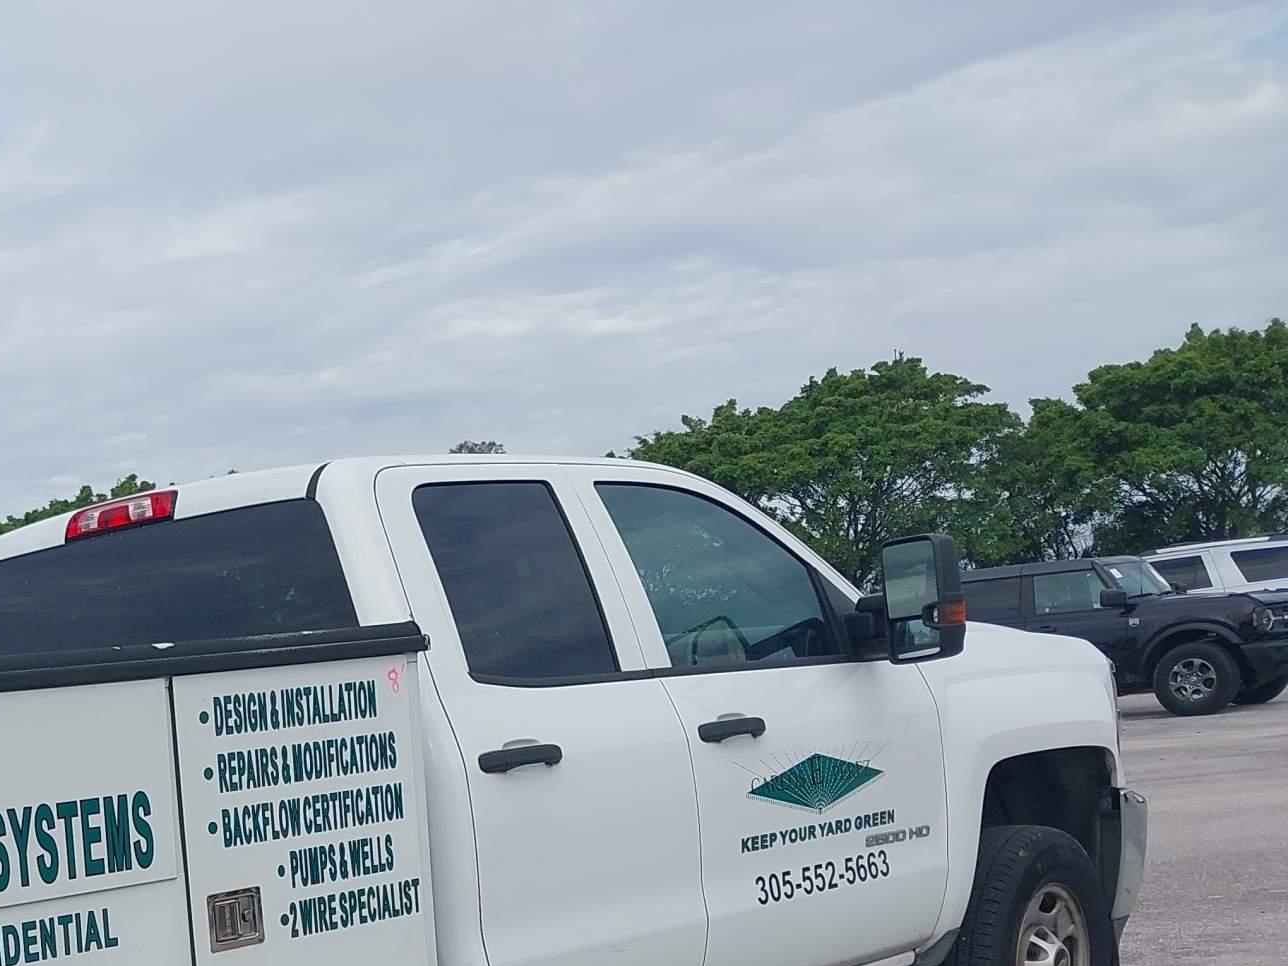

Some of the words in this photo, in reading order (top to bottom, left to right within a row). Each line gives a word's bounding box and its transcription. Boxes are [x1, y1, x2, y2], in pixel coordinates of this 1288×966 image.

[213, 691, 268, 736] DESIGN
[270, 690, 280, 731] &
[280, 679, 377, 729] INSTALLATION
[217, 745, 280, 793] REPAIRS
[281, 745, 291, 784] &
[291, 731, 397, 783] MODIFICATIONS
[221, 797, 301, 848] BACKFLOW
[302, 782, 404, 835] CERTIFICATION
[741, 832, 777, 853] KEEP
[779, 824, 817, 845] YOUR
[818, 818, 852, 837] YARD
[854, 808, 895, 830] GREEN
[289, 843, 338, 888] PUMPS
[339, 841, 349, 879] &
[348, 833, 394, 878] WELLS
[755, 849, 890, 906] 305-552-5663
[289, 902, 299, 938] 2
[299, 894, 338, 935] WIRE
[339, 878, 420, 928] SPECIALIST
